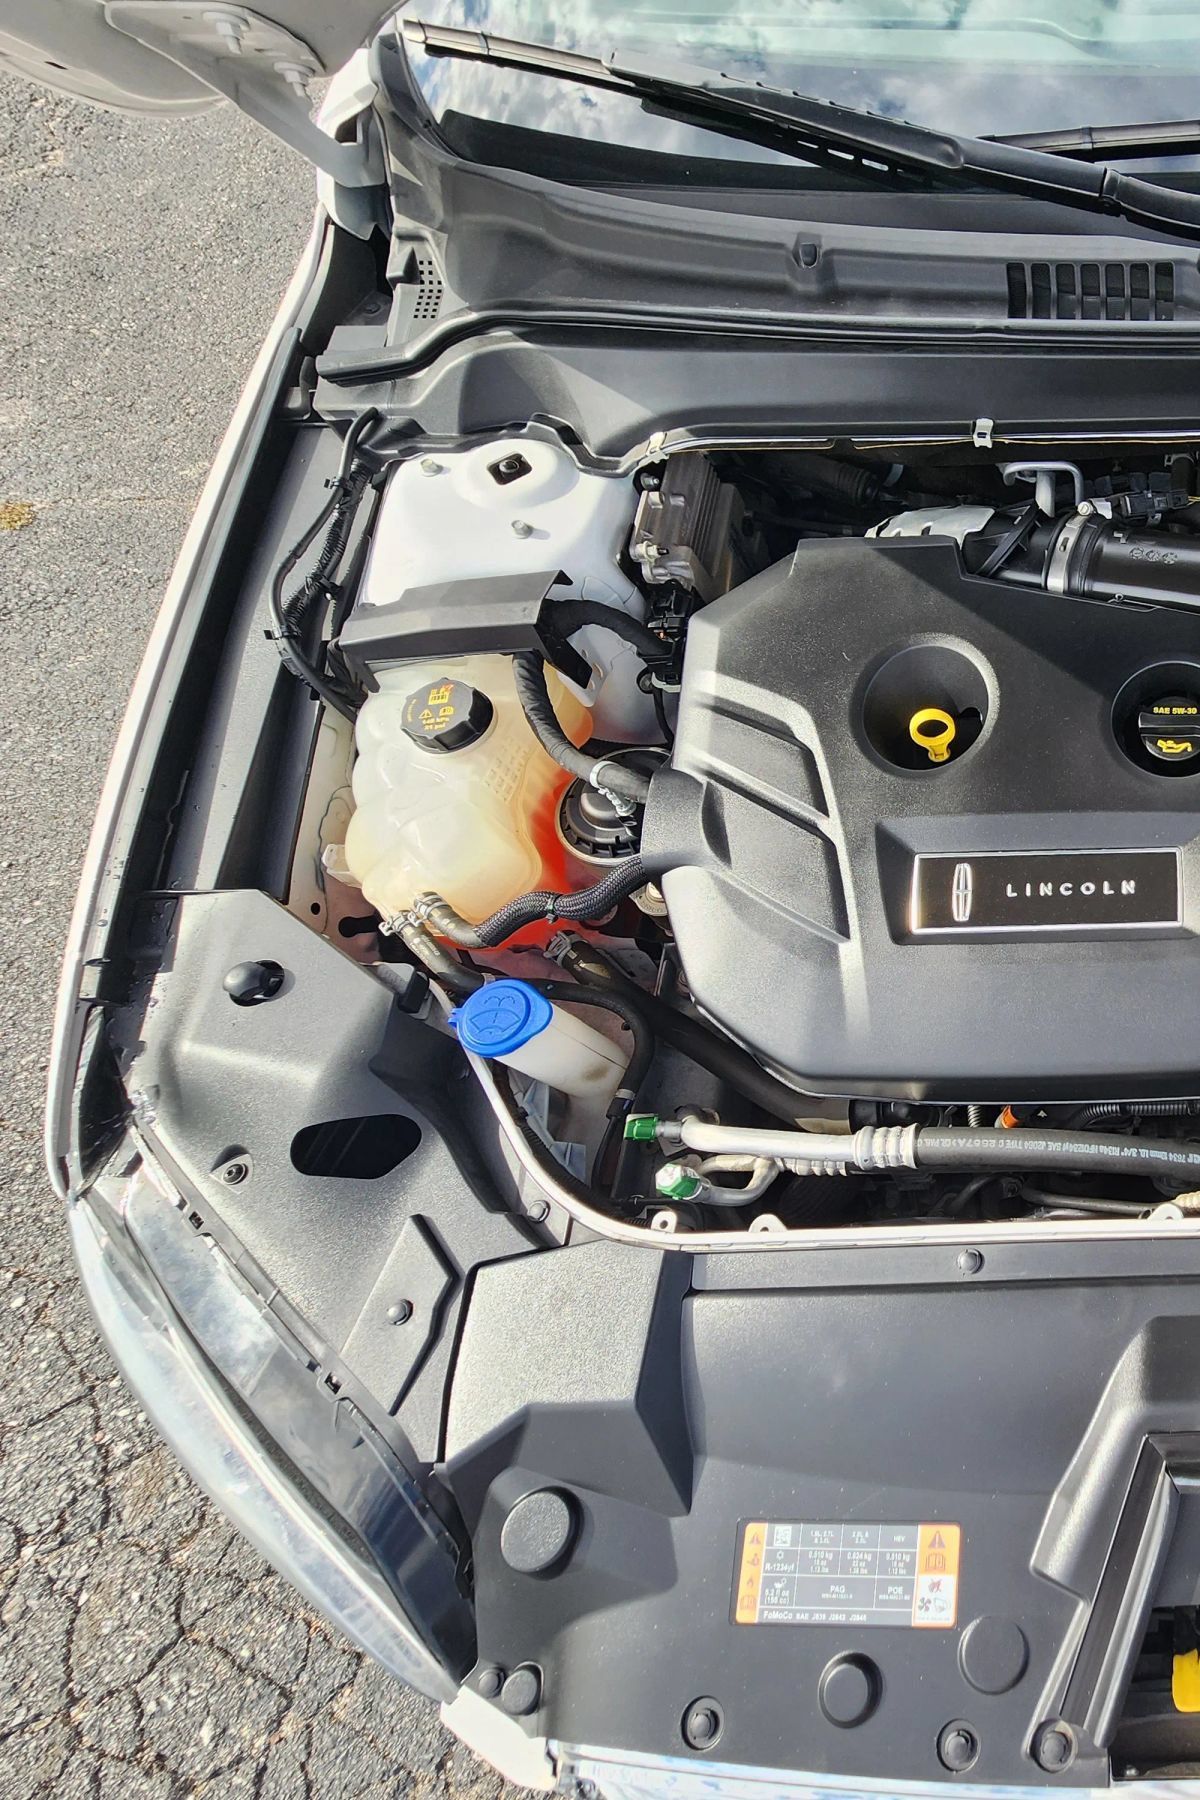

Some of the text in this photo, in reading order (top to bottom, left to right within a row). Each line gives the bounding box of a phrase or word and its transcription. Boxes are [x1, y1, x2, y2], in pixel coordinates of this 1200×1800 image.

[1006, 880, 1136, 898] LINCOLN
[1005, 1140, 1023, 1149] TYPE
[1048, 1141, 1062, 1152] SAE
[765, 1562, 795, 1572] R-1234yf
[887, 1586, 903, 1594] POE
[763, 1611, 793, 1619] FoMoCo
